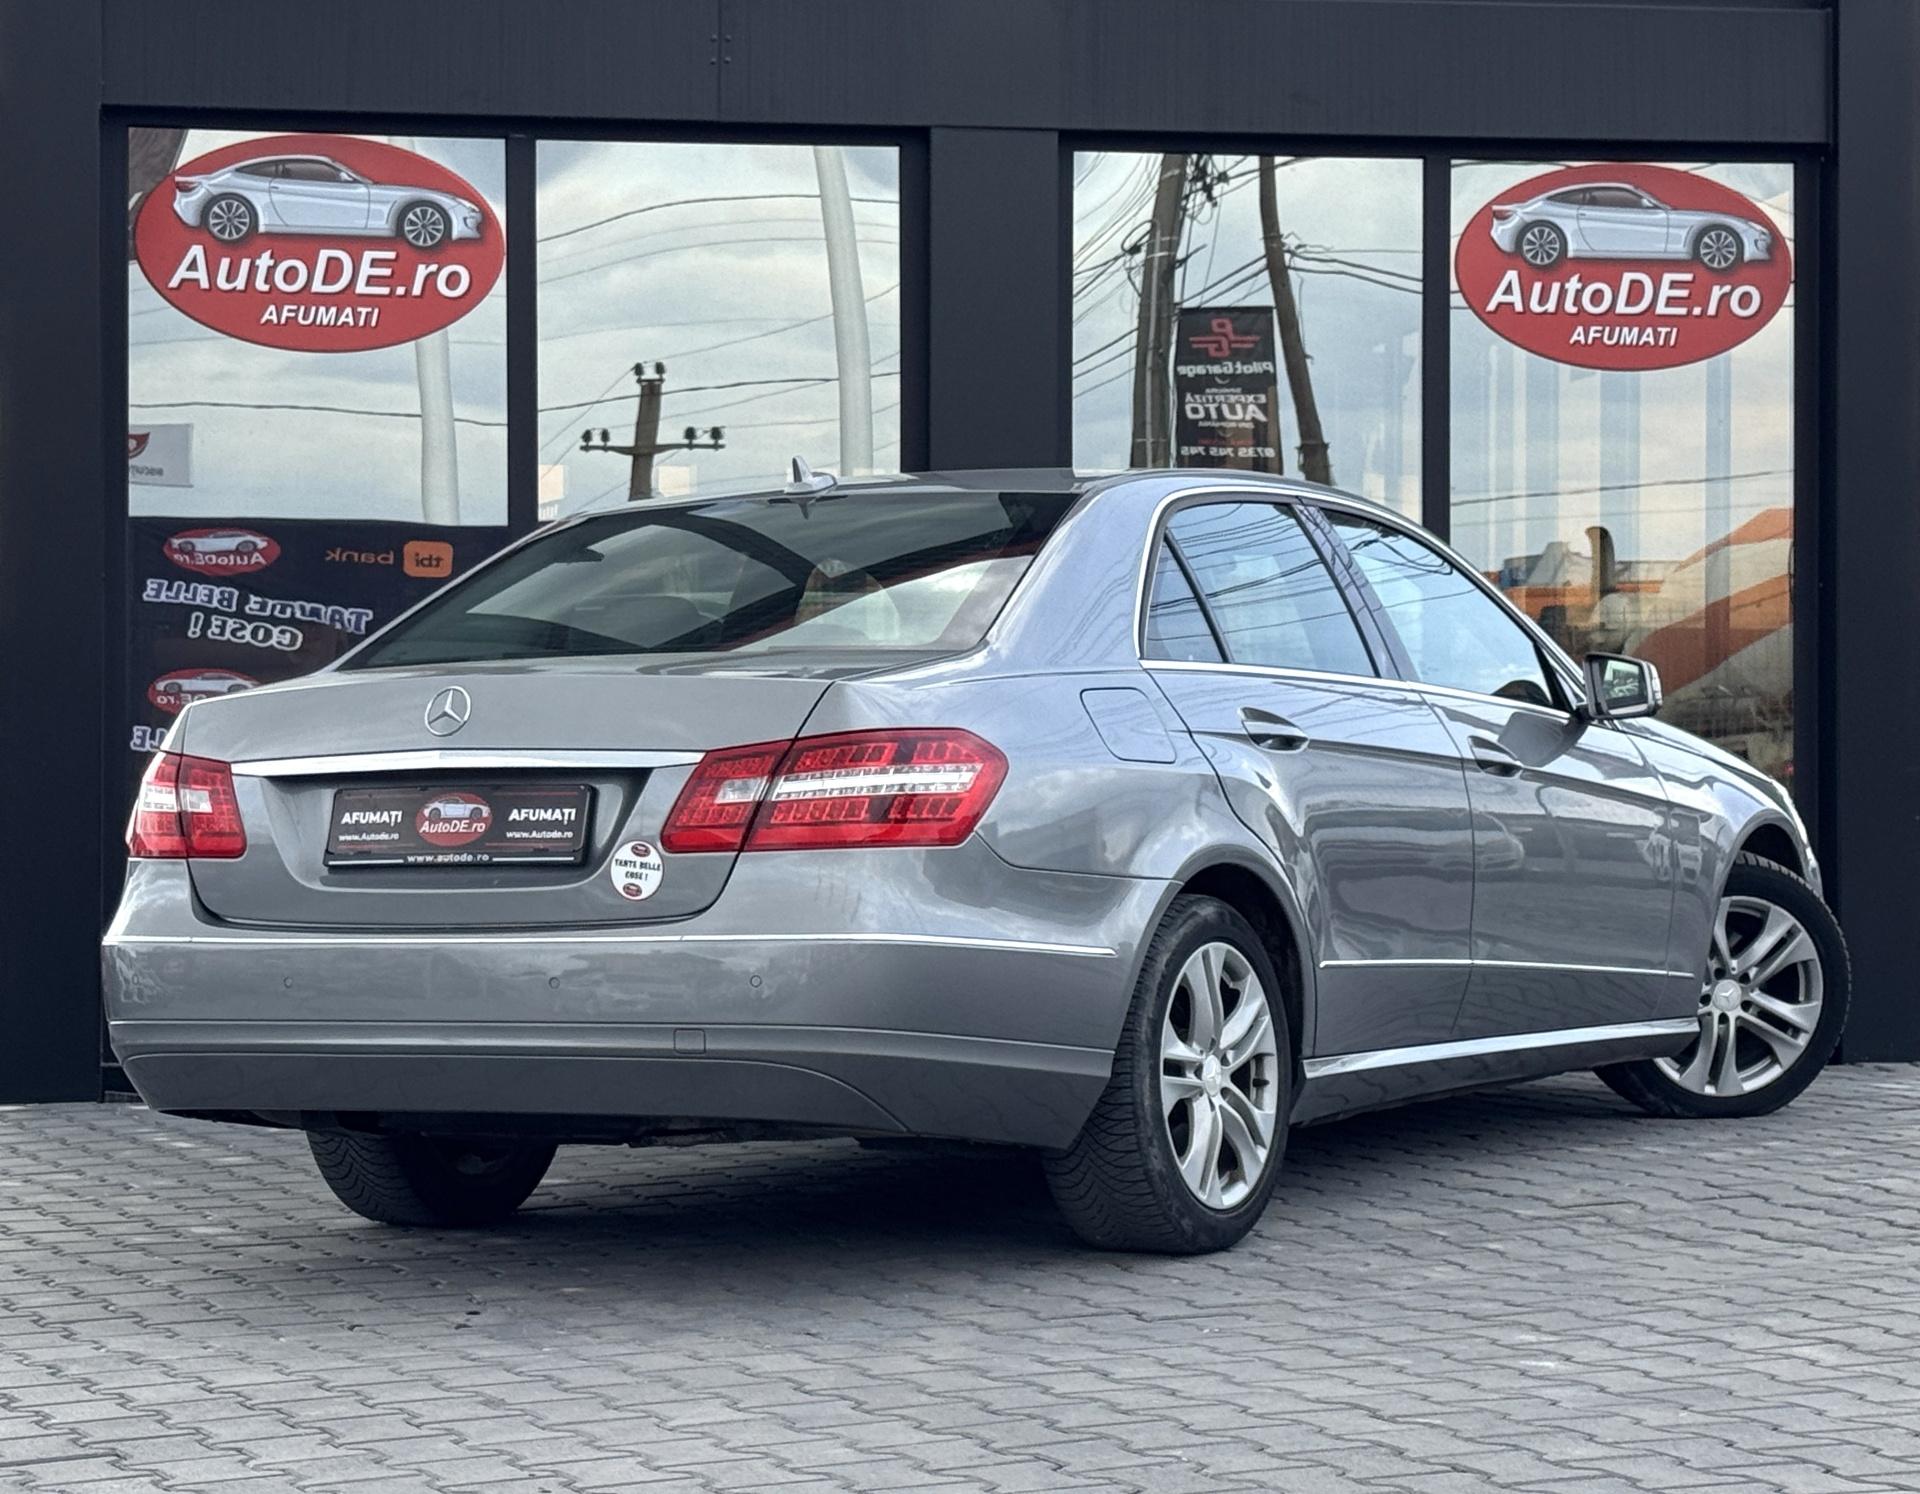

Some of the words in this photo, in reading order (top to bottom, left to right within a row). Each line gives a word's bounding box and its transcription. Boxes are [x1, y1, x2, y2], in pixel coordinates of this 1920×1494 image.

[168, 244, 470, 298] AutoDE.ro
[1486, 270, 1761, 317] AutoDE.ro
[260, 304, 379, 327] AFUMATI
[1570, 326, 1678, 347] AFUMATI
[419, 819, 486, 834] AutoDE.ro
[407, 853, 490, 864] www.autode.ro
